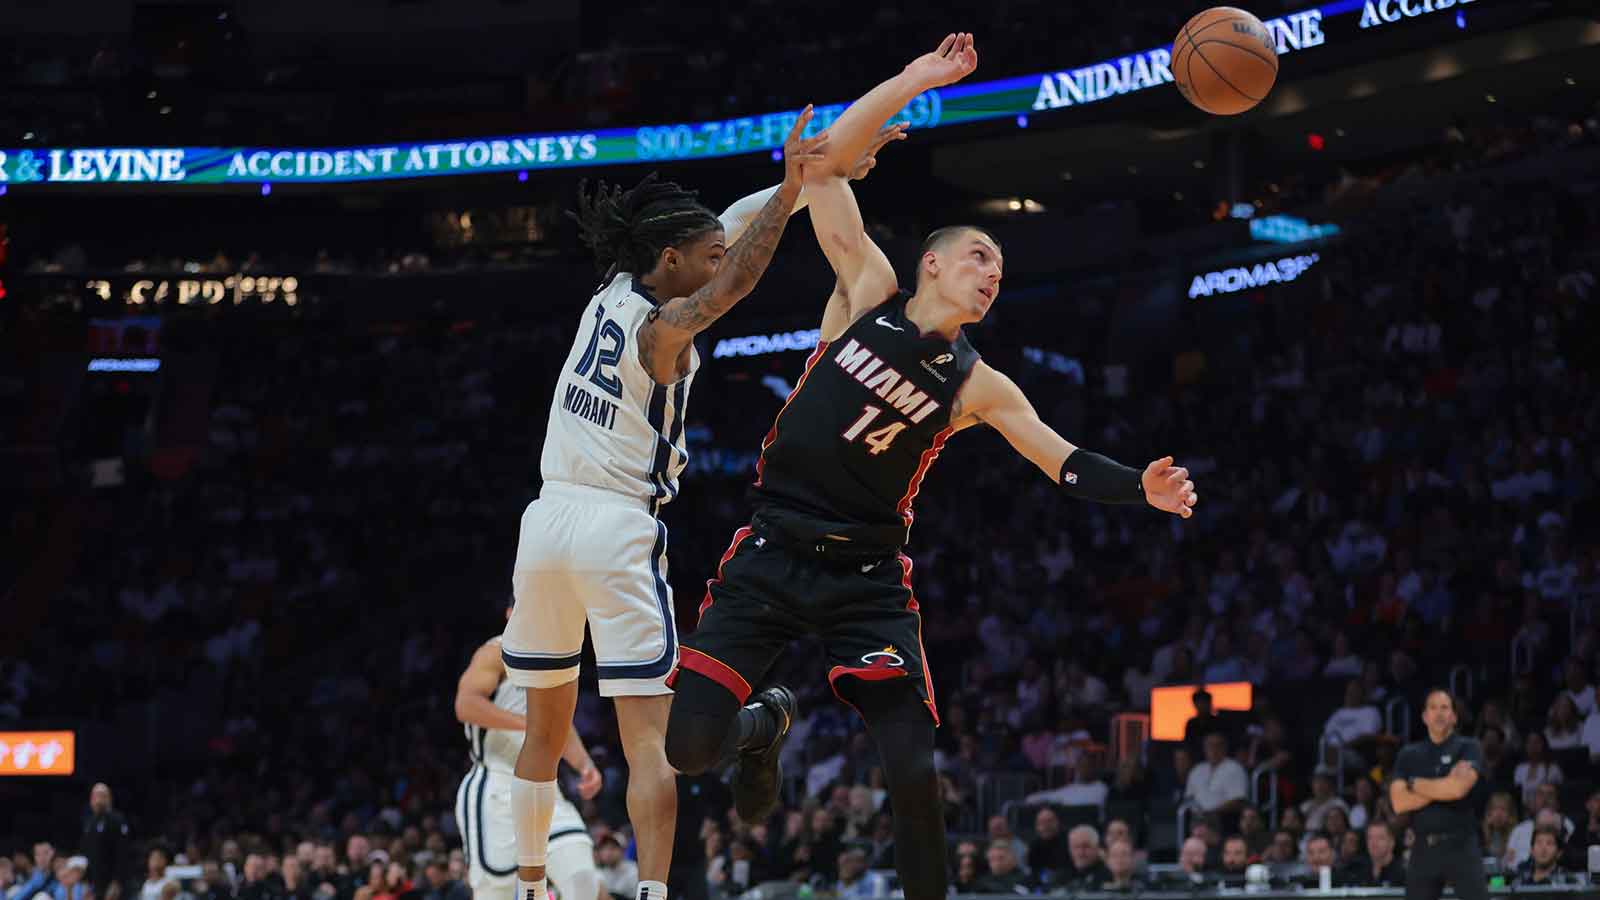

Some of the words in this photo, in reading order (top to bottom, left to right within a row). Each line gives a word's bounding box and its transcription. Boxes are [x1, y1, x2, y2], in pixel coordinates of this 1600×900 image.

[15, 149, 44, 181] &
[48, 149, 186, 182] LEVINE
[227, 147, 399, 176] ACCIDENT
[404, 134, 597, 171] ATTORNEYS
[1032, 48, 1174, 110] ANIDJAR
[574, 303, 626, 400] 12
[834, 338, 940, 425] MIAMI
[562, 382, 620, 431] MORANT
[842, 405, 908, 456] 14
